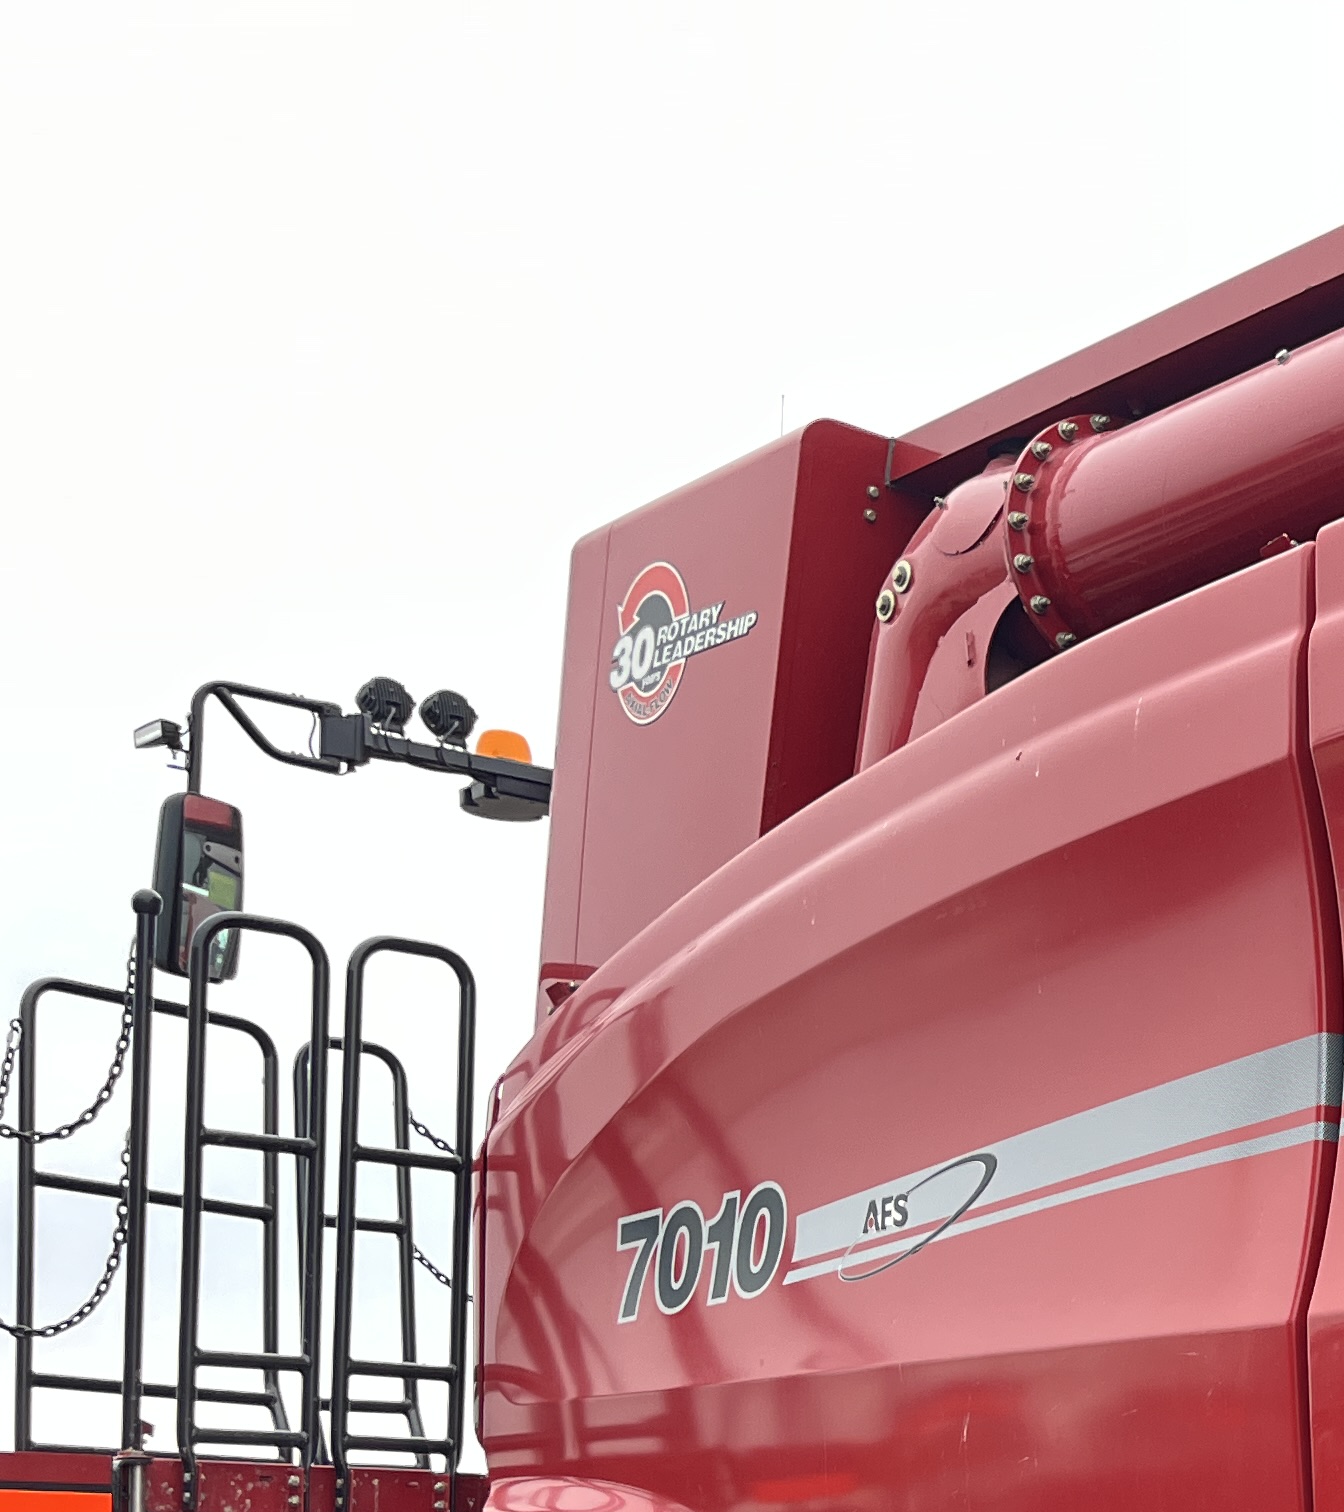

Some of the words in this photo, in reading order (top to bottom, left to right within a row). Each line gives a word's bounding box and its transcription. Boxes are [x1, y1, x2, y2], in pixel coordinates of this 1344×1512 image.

[652, 611, 758, 669] LEADERSHIP
[656, 601, 723, 646] ROTARY
[609, 626, 655, 689] 30
[862, 1193, 910, 1235] AFS
[617, 1180, 787, 1325] 7010
